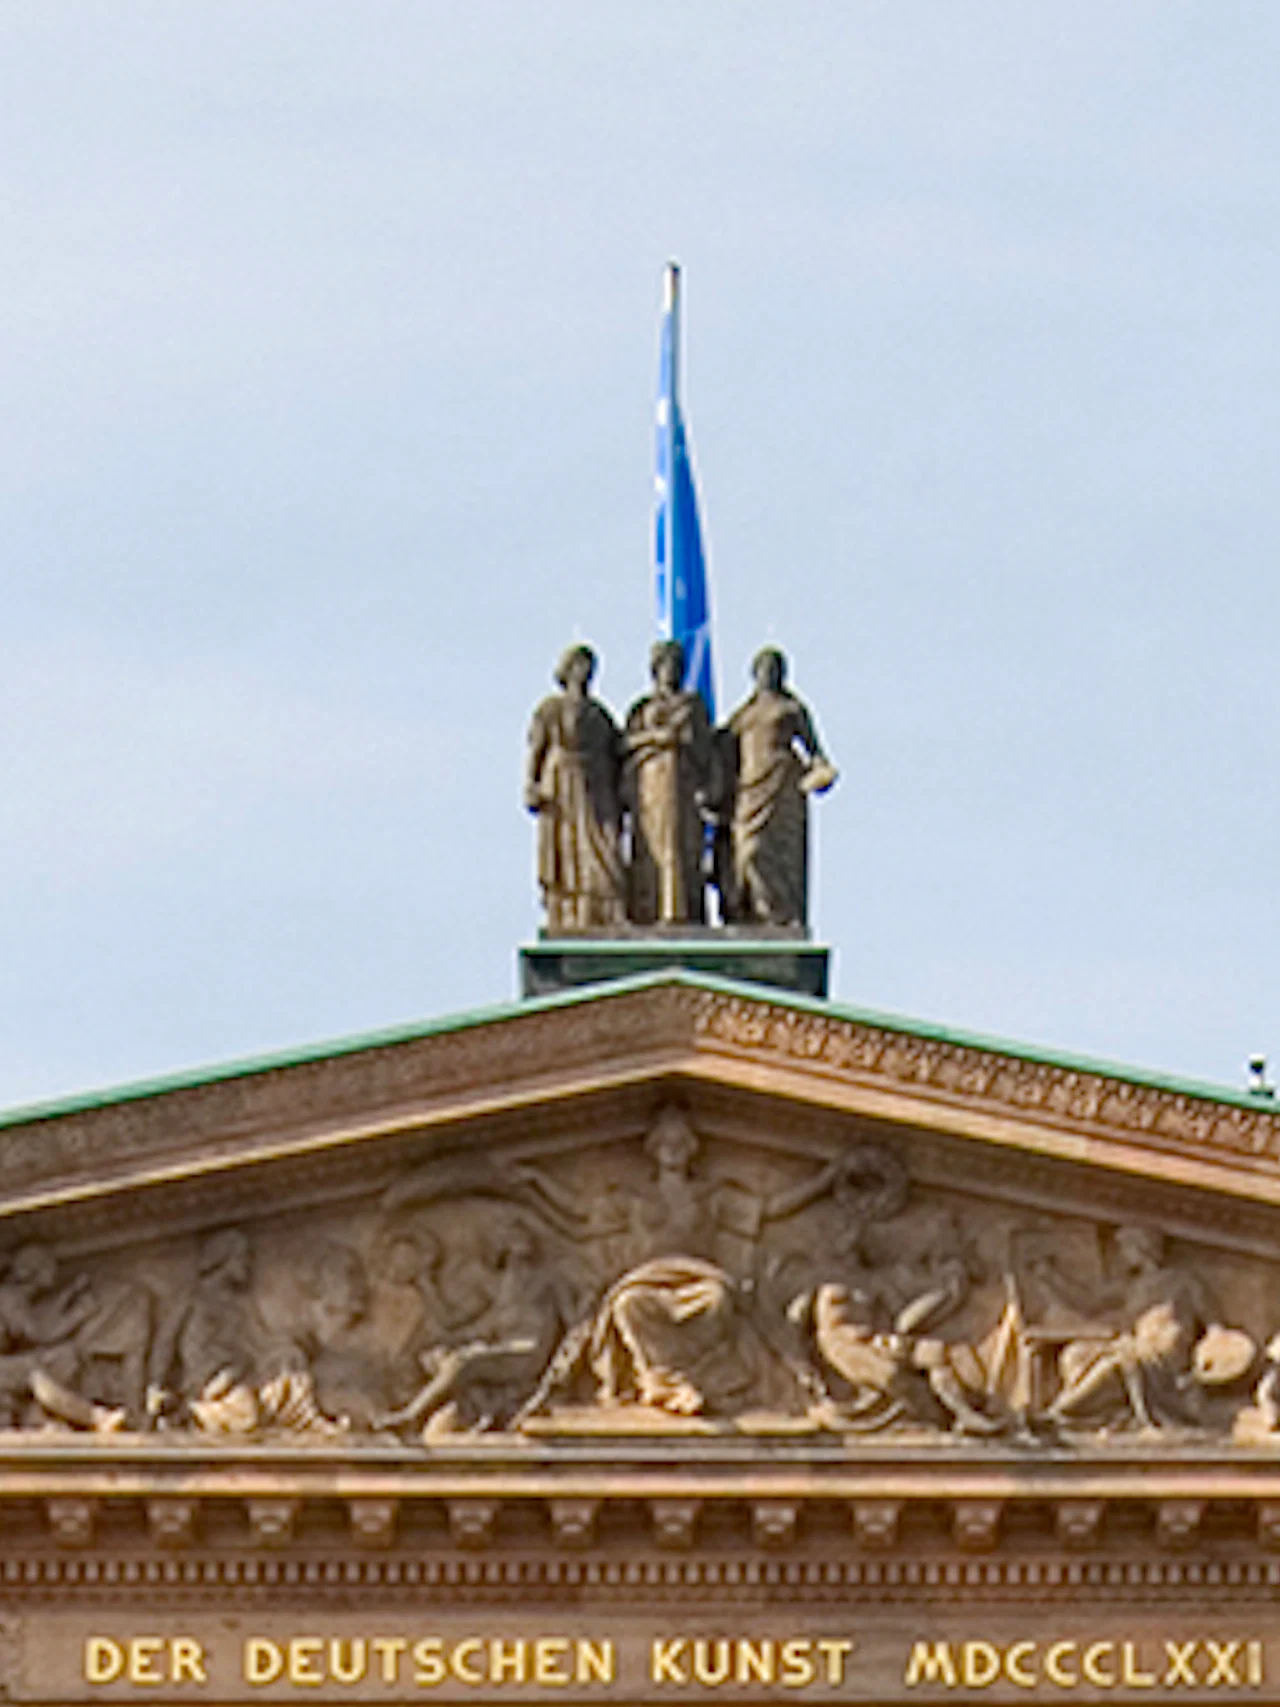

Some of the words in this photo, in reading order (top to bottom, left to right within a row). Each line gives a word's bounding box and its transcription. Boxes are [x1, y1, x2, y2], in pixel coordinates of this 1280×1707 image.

[84, 1637, 208, 1684] DER
[245, 1636, 614, 1685] DEUTSCHEN
[651, 1638, 854, 1686] KUNST
[905, 1640, 1262, 1687] MDCCCLXXI
